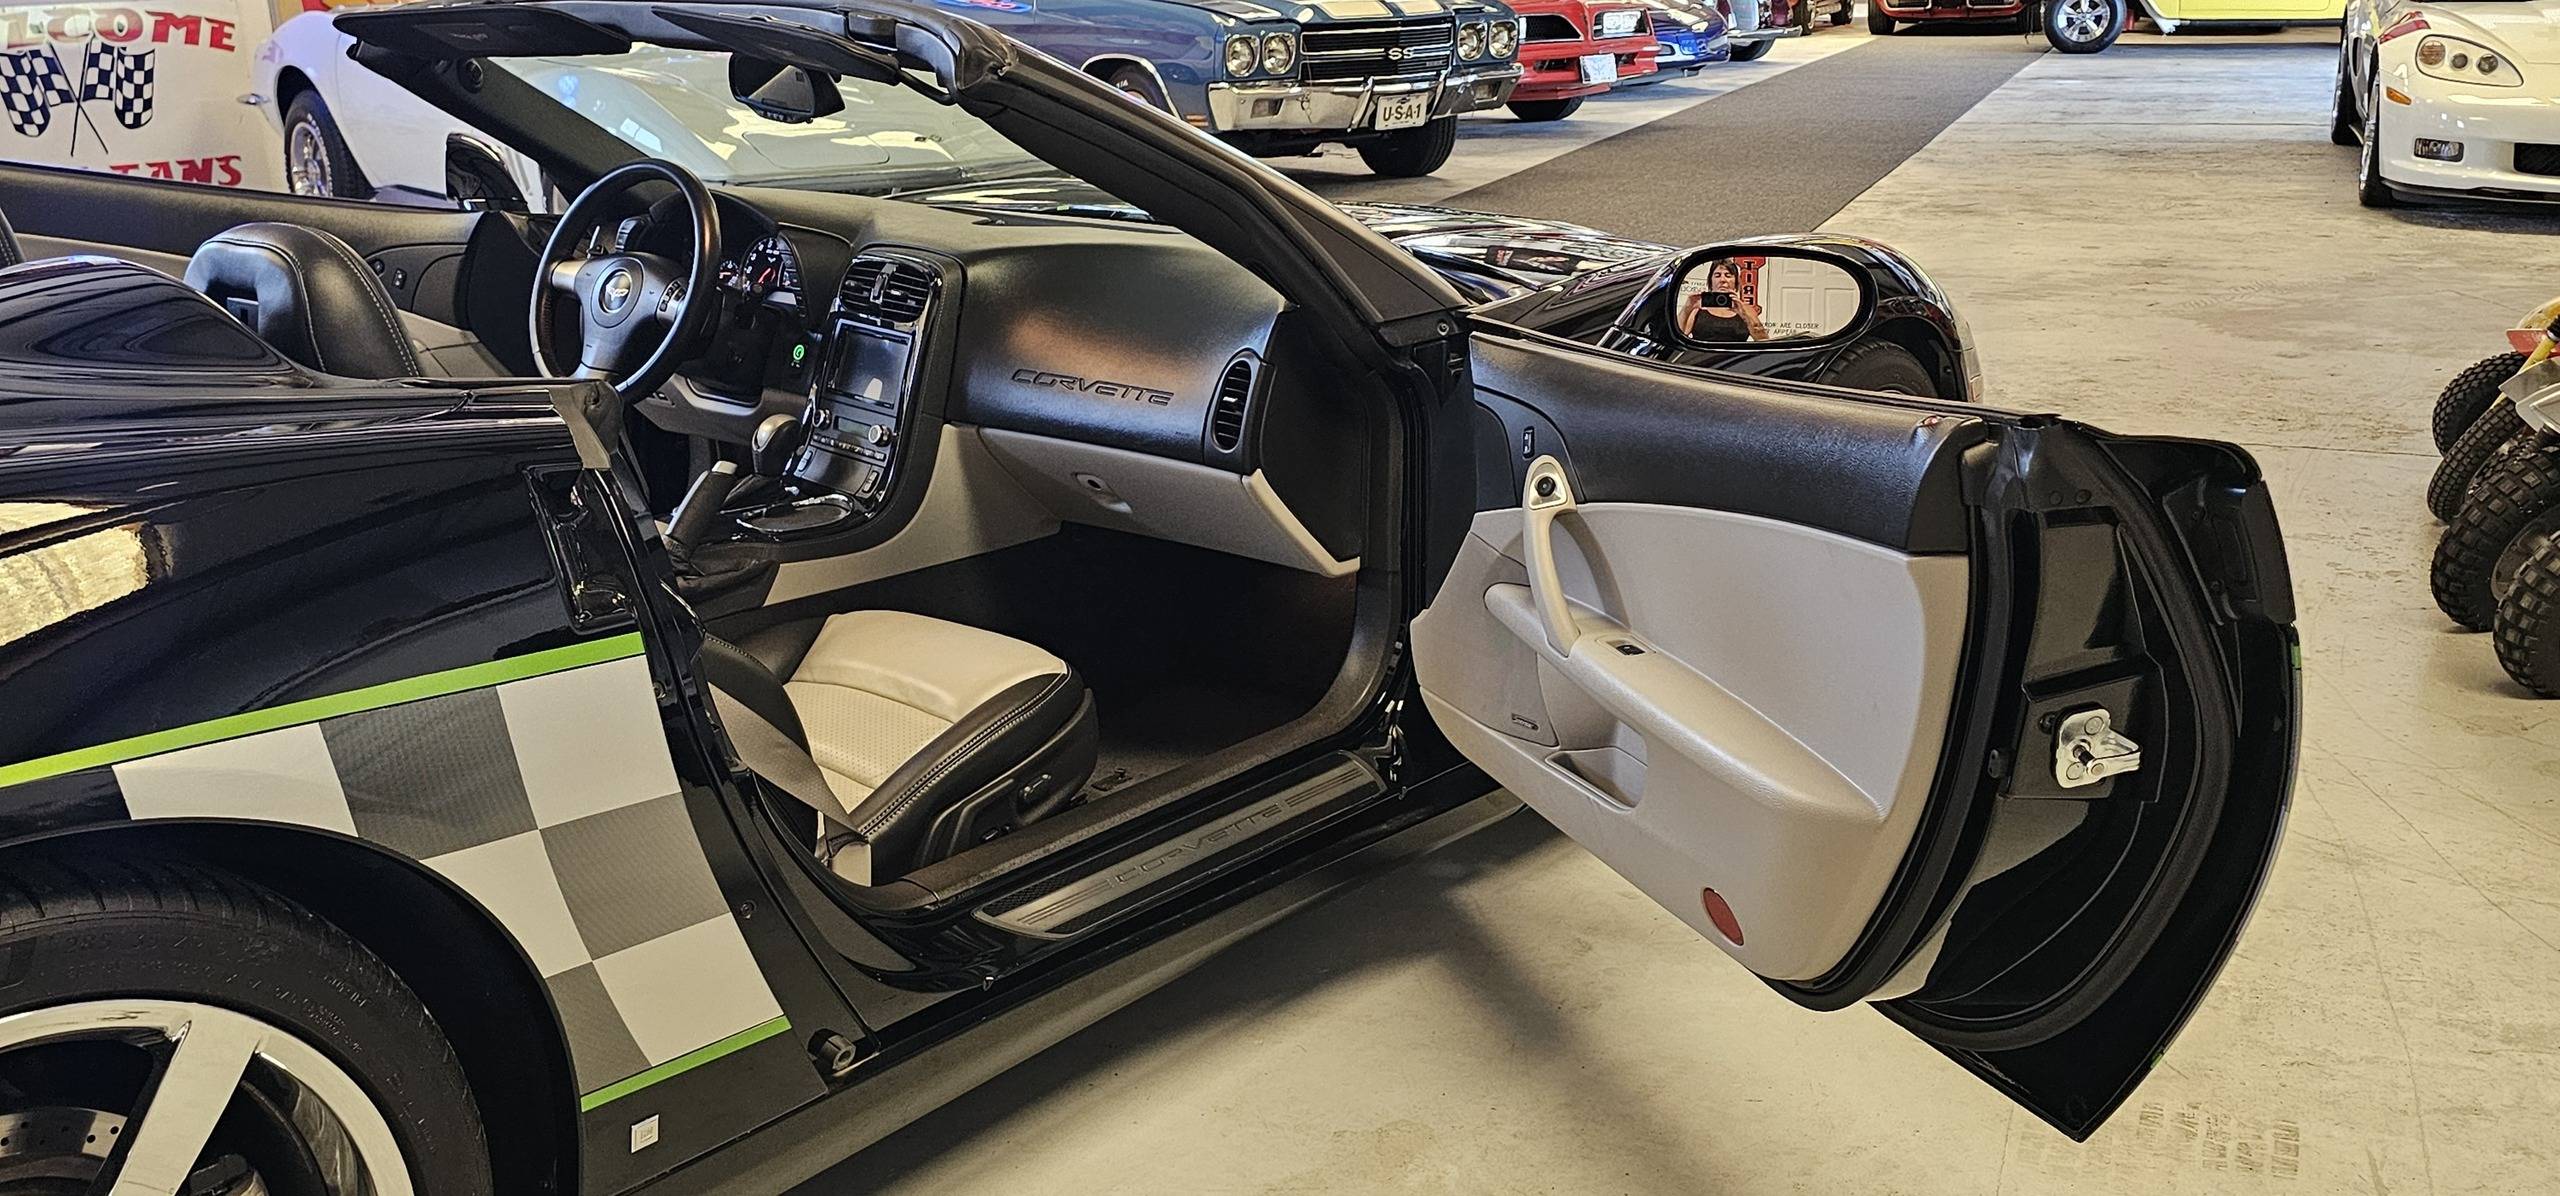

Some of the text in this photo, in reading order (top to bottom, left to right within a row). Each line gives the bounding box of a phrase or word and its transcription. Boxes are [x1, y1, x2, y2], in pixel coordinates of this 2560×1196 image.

[1388, 46, 1414, 60] SS
[1011, 368, 1175, 407] CORVETTE
[1114, 802, 1283, 885] CORVETTE
